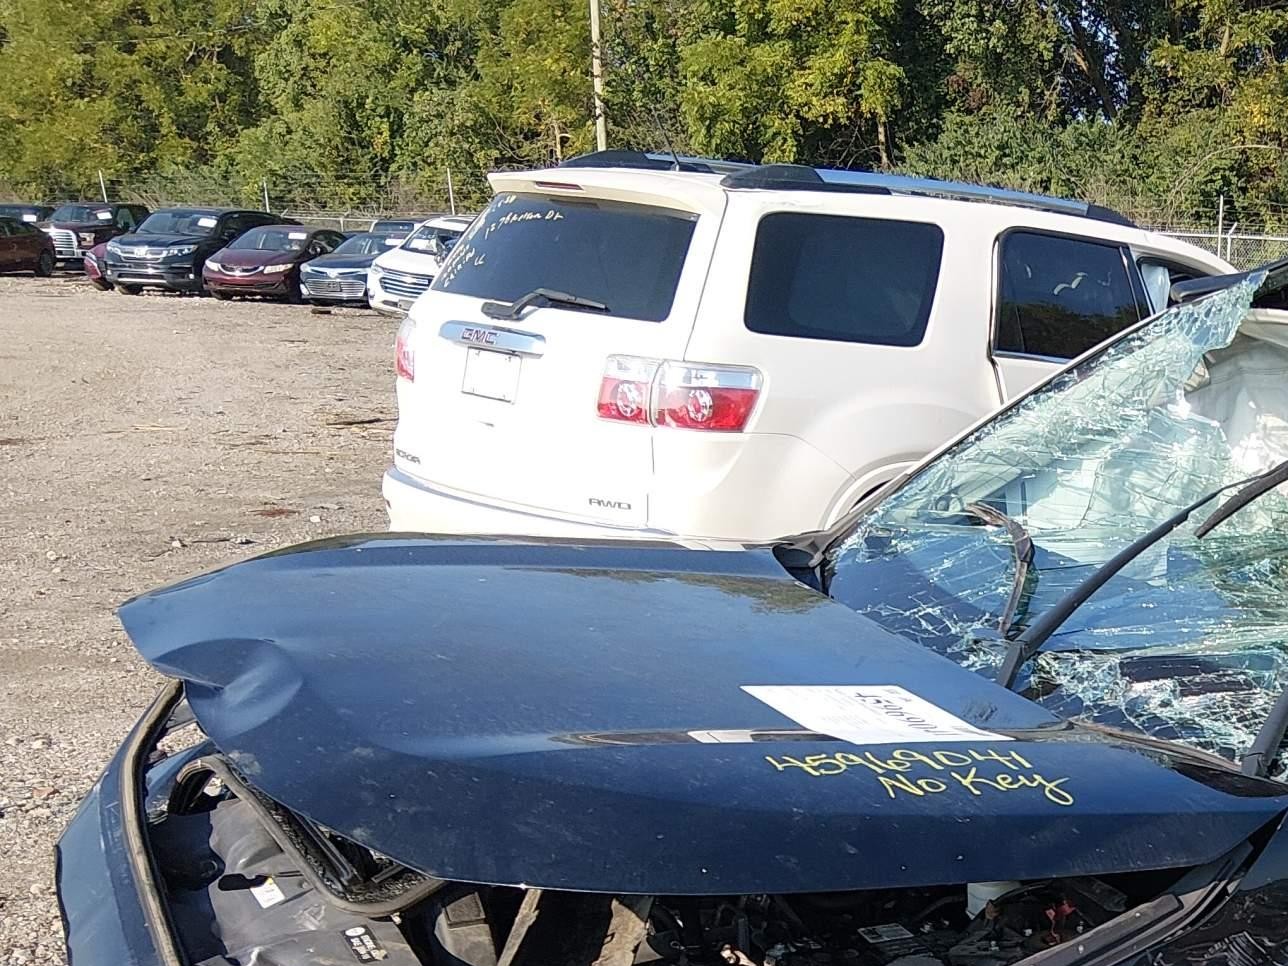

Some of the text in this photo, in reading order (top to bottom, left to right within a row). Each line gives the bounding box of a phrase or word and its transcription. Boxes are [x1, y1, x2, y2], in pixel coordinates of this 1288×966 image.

[461, 327, 498, 345] GMC
[588, 497, 633, 511] AWD
[766, 749, 1033, 777] 45969041
[877, 766, 1075, 807] No Key
